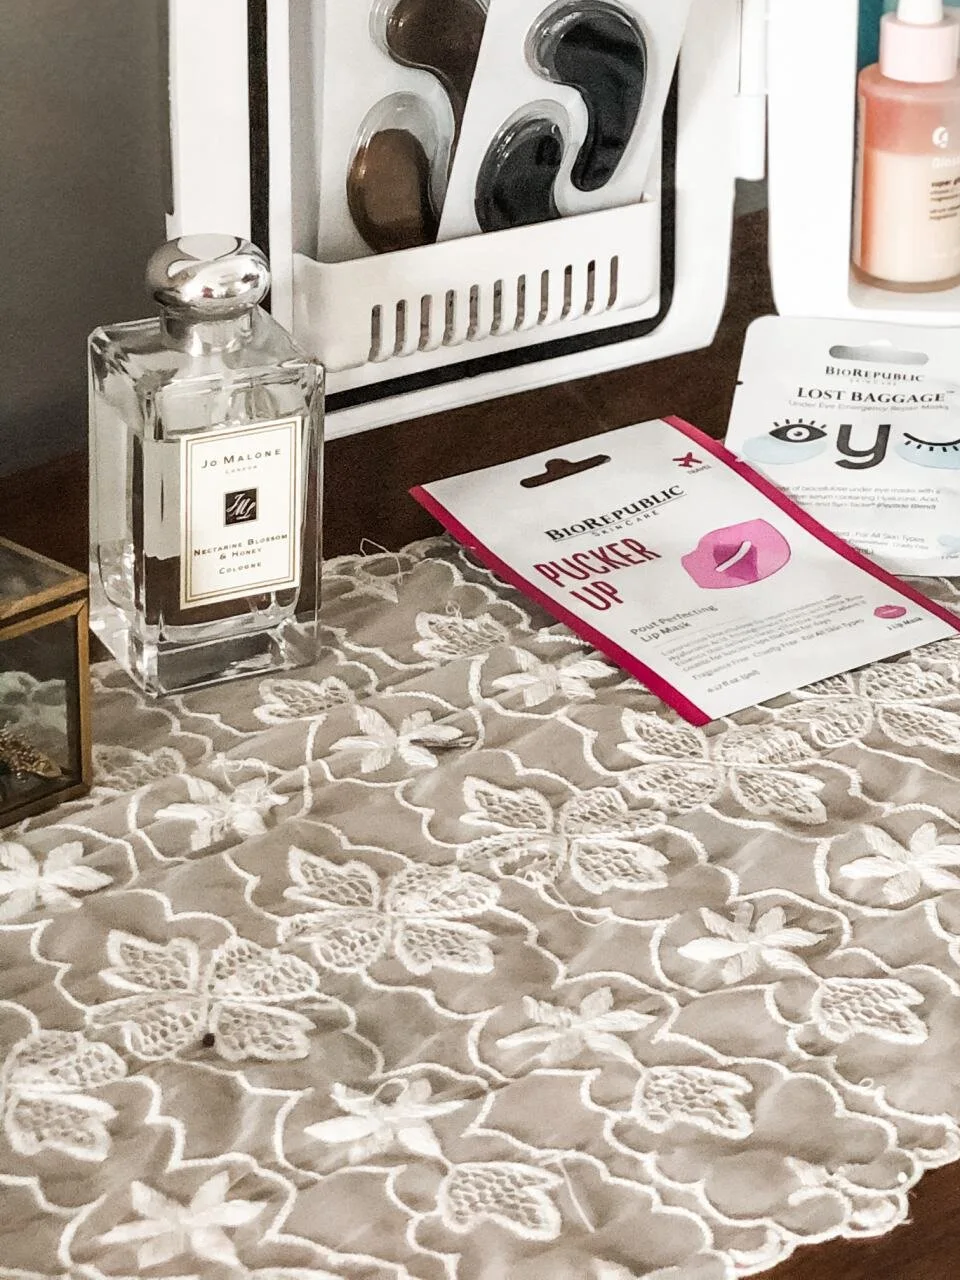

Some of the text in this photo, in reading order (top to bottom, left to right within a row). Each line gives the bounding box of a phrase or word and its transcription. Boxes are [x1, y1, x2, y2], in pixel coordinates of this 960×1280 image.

[797, 387, 846, 401] LOST
[789, 400, 816, 408] Under
[819, 400, 836, 409] Eye
[223, 448, 282, 464] MALONE
[591, 509, 661, 537] SKINCARE
[231, 548, 262, 558] HONEY
[218, 561, 262, 575] COLOGNE
[533, 538, 662, 588] PUCKER
[569, 580, 624, 611] UP
[630, 604, 719, 636] Pout Perfecting
[640, 629, 662, 643] Lip
[660, 620, 692, 635] Mask
